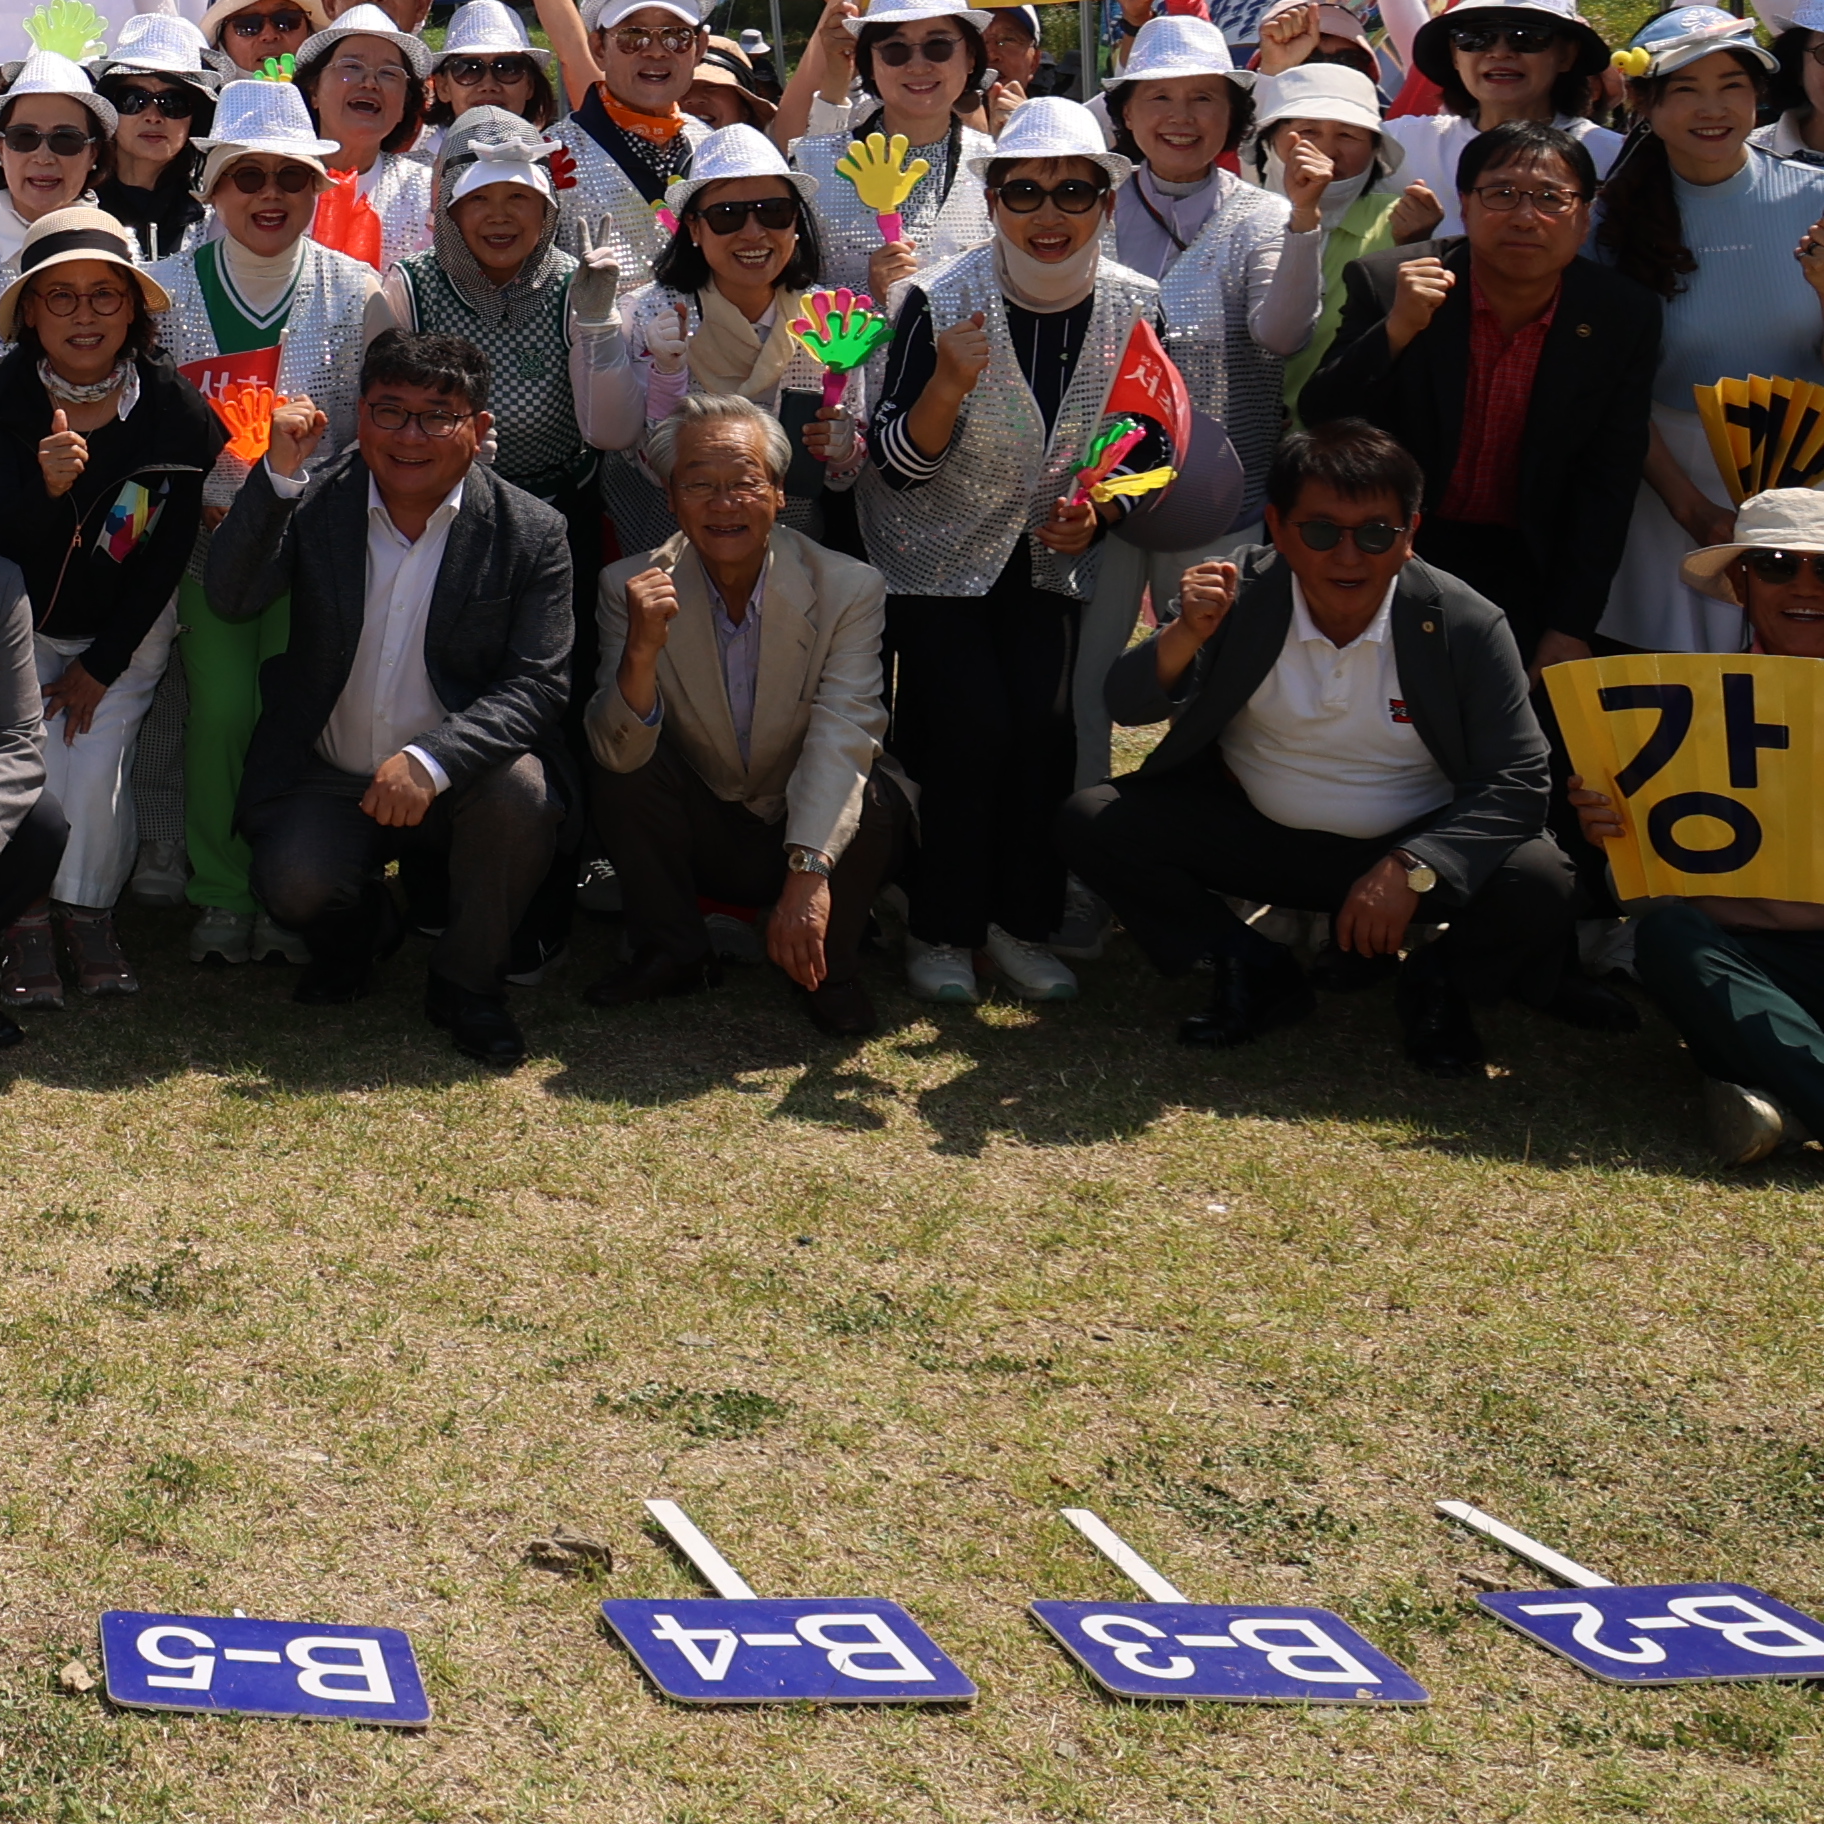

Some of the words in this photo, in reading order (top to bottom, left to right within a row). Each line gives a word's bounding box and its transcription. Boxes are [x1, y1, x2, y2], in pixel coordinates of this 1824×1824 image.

[1598, 672, 1790, 875] 강
[135, 1624, 397, 1706] B-5
[651, 1612, 938, 1683] B-4
[1079, 1613, 1384, 1685] B-3
[1518, 1593, 1824, 1665] B-2
